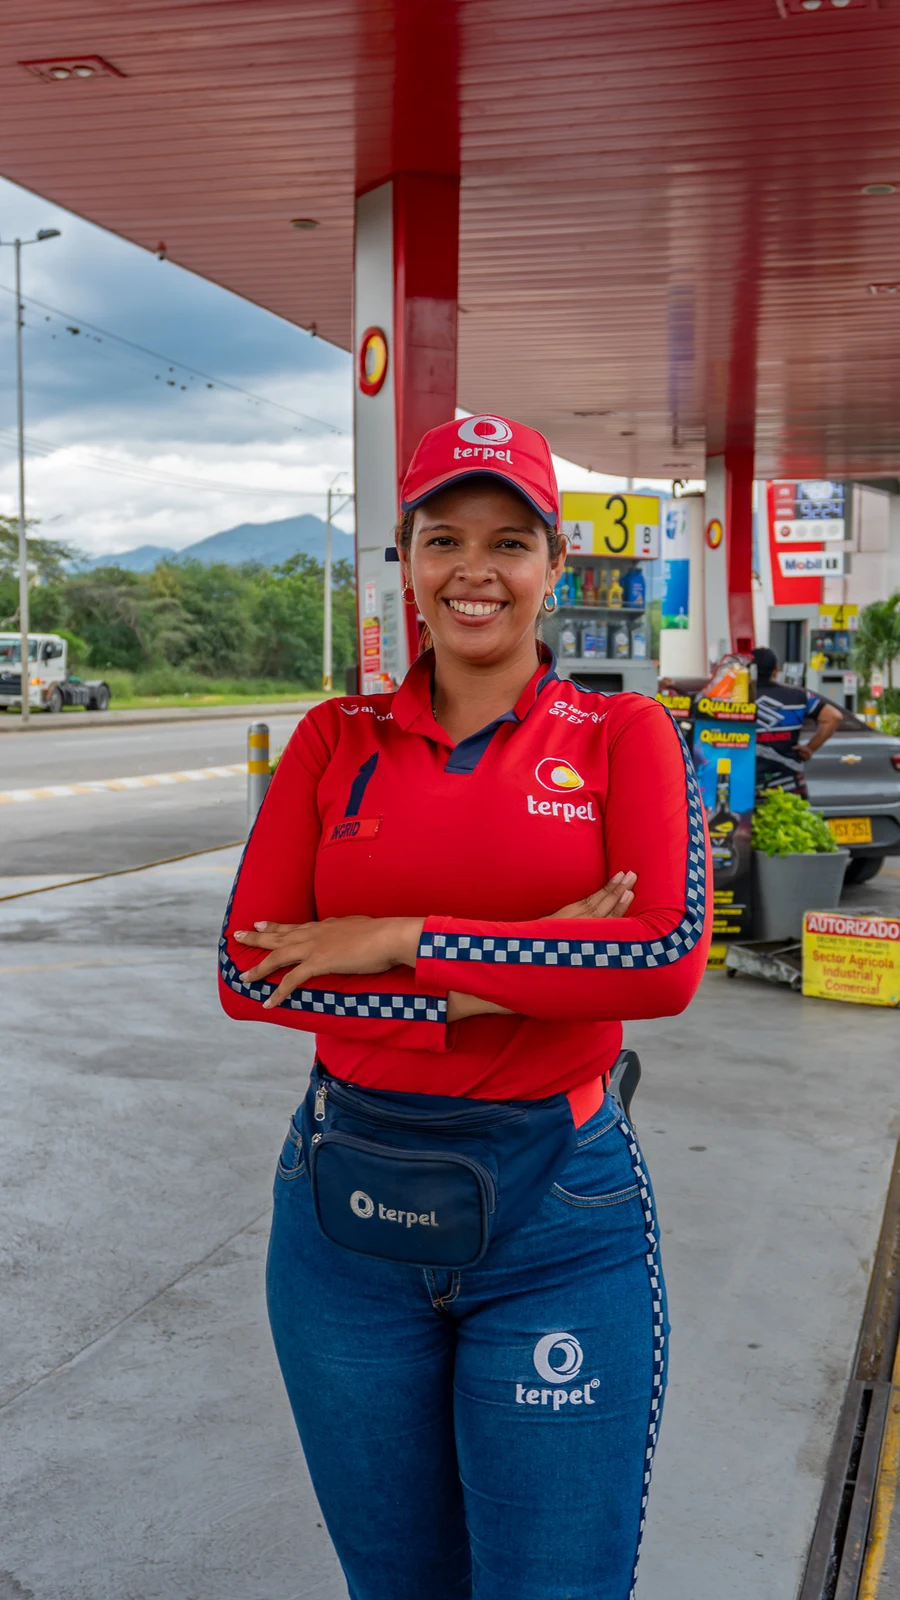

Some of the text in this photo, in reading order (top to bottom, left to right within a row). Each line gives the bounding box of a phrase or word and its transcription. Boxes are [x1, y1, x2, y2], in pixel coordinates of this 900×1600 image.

[453, 446, 514, 465] terpel
[571, 522, 582, 540] A
[603, 494, 629, 554] 3
[643, 526, 651, 544] B
[785, 558, 822, 570] Mobil
[834, 605, 844, 624] 4
[698, 698, 757, 718] QUALITOR
[700, 729, 750, 747] QUALITOR
[526, 795, 596, 823] terpel
[331, 821, 361, 840] INGRID
[808, 917, 900, 939] AUTORIZADO
[812, 949, 847, 964] Sector
[823, 965, 883, 987] Industrial y
[825, 978, 880, 995] Comercial
[378, 1203, 439, 1228] terpel
